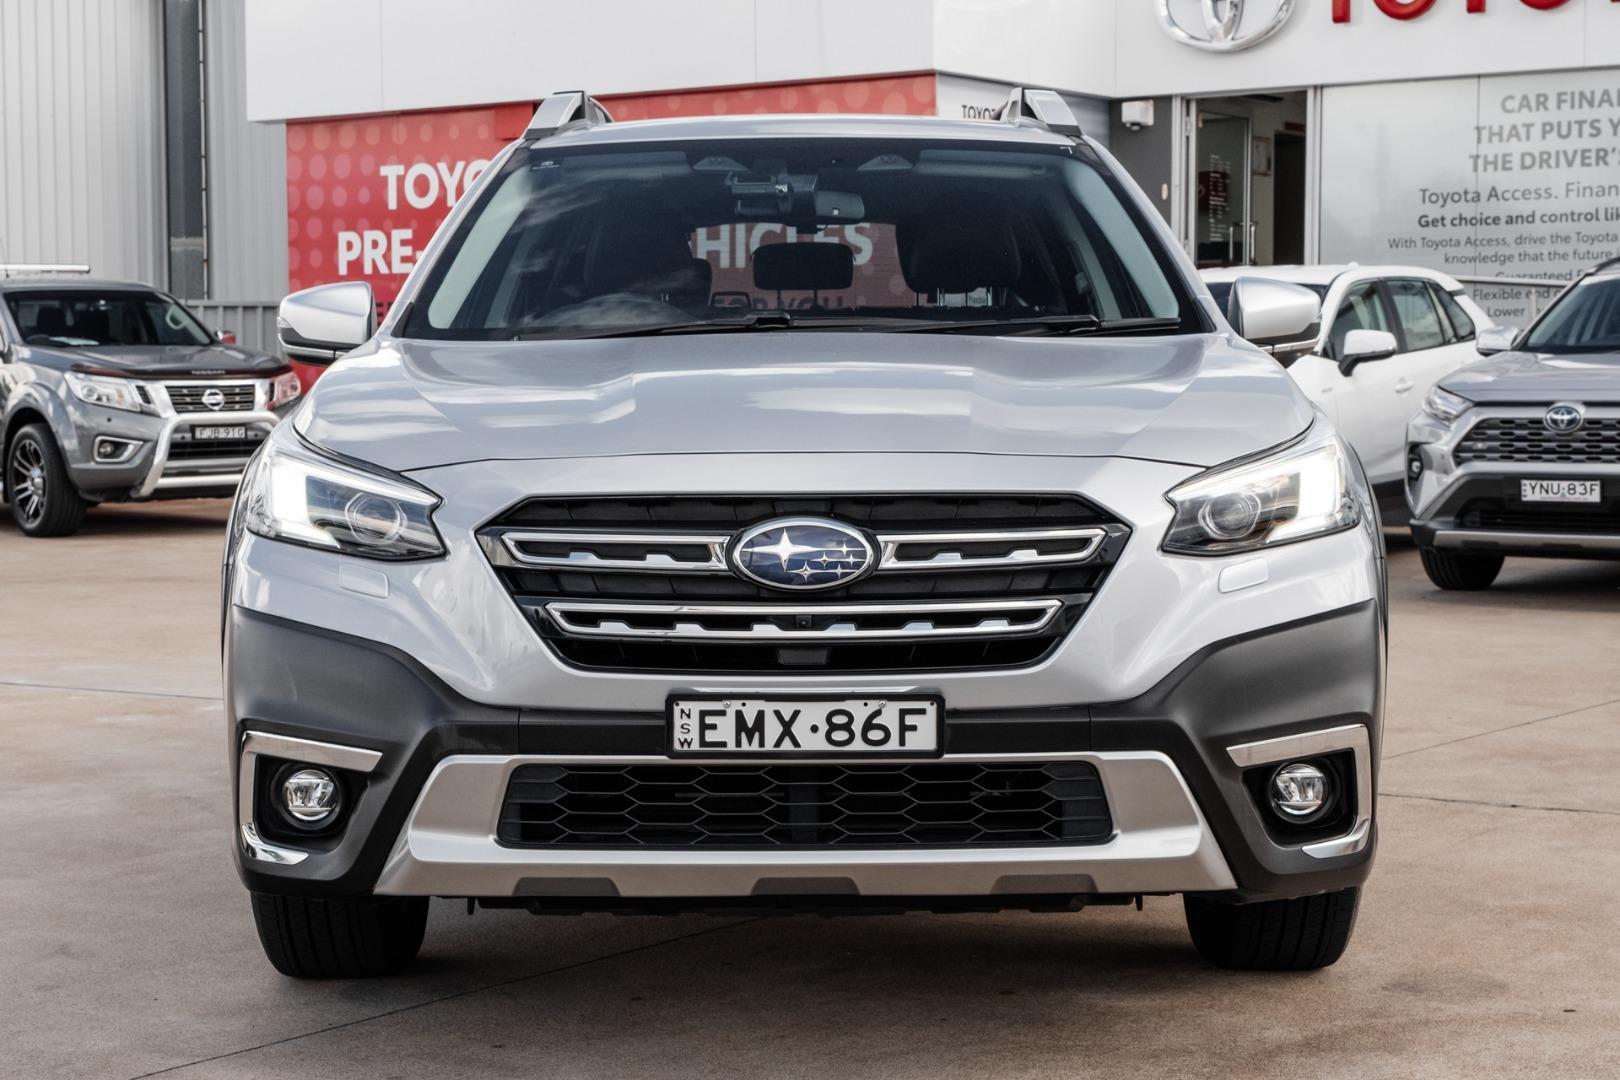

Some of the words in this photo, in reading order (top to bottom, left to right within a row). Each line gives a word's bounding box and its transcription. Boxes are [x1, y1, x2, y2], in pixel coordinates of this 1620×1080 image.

[1501, 93, 1549, 113] CAR
[1556, 88, 1620, 110] FINA
[962, 105, 995, 120] TOYO
[1474, 122, 1535, 144] THAT
[1541, 119, 1602, 140] PUTS
[1469, 152, 1513, 173] THE
[1520, 148, 1620, 171] DRIVER'
[1419, 188, 1481, 208] Toyota
[1486, 185, 1558, 202] Access.
[1418, 214, 1446, 228] Get
[1450, 211, 1501, 227] choice
[1505, 211, 1536, 225] and
[1540, 208, 1600, 223] control
[1388, 236, 1417, 249] With
[1420, 236, 1461, 250] Toyota
[1464, 235, 1511, 249] Access,
[1514, 233, 1546, 246] drive
[1550, 233, 1571, 245] the
[1575, 231, 1618, 246] Toyota
[1444, 252, 1514, 266] knowledge
[1518, 250, 1544, 263] that
[1547, 249, 1569, 261] the
[1572, 247, 1613, 261] future
[1473, 288, 1522, 301] Flexible
[1487, 306, 1525, 318] Lower
